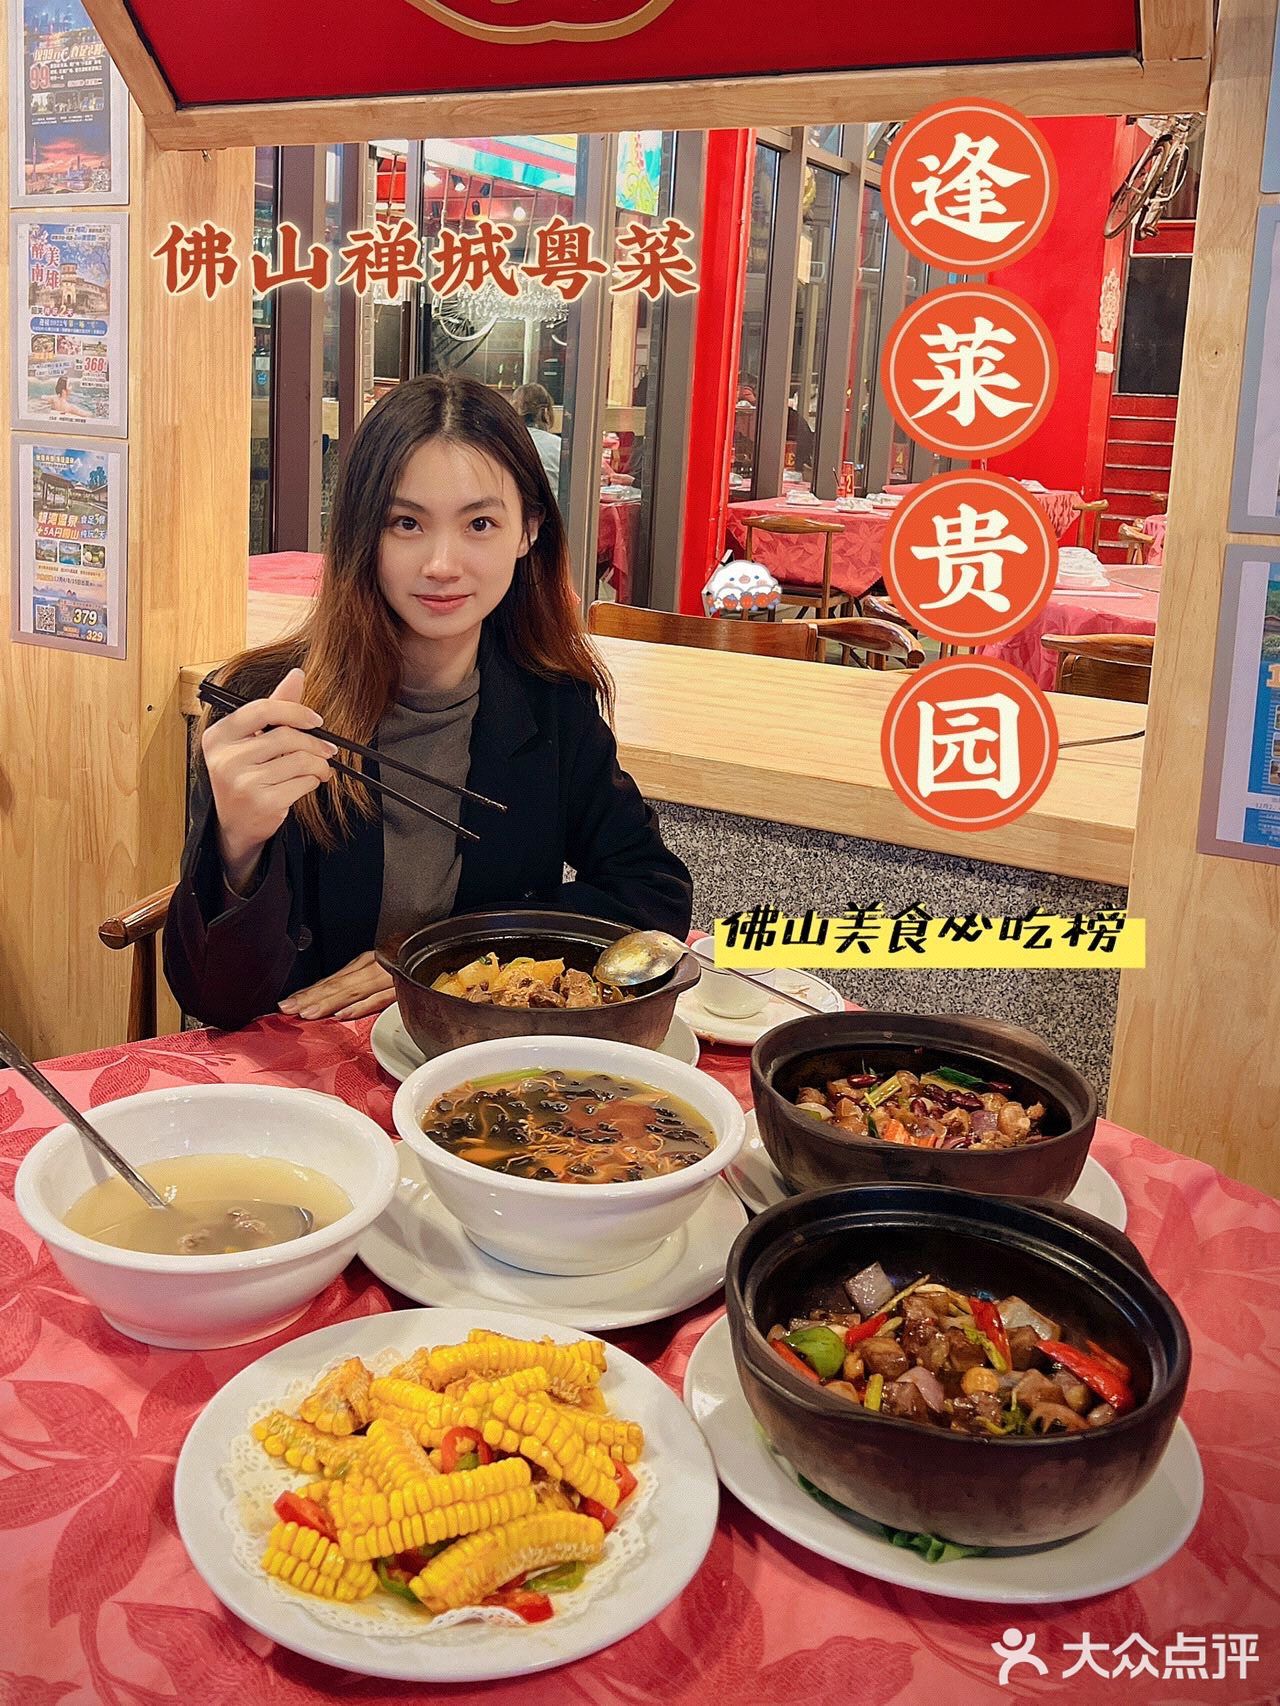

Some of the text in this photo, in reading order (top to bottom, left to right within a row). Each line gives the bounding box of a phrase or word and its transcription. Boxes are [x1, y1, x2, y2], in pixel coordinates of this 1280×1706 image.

[30, 63, 50, 89] 99
[84, 357, 104, 371] 368
[73, 607, 98, 626] 379
[86, 629, 104, 643] 329
